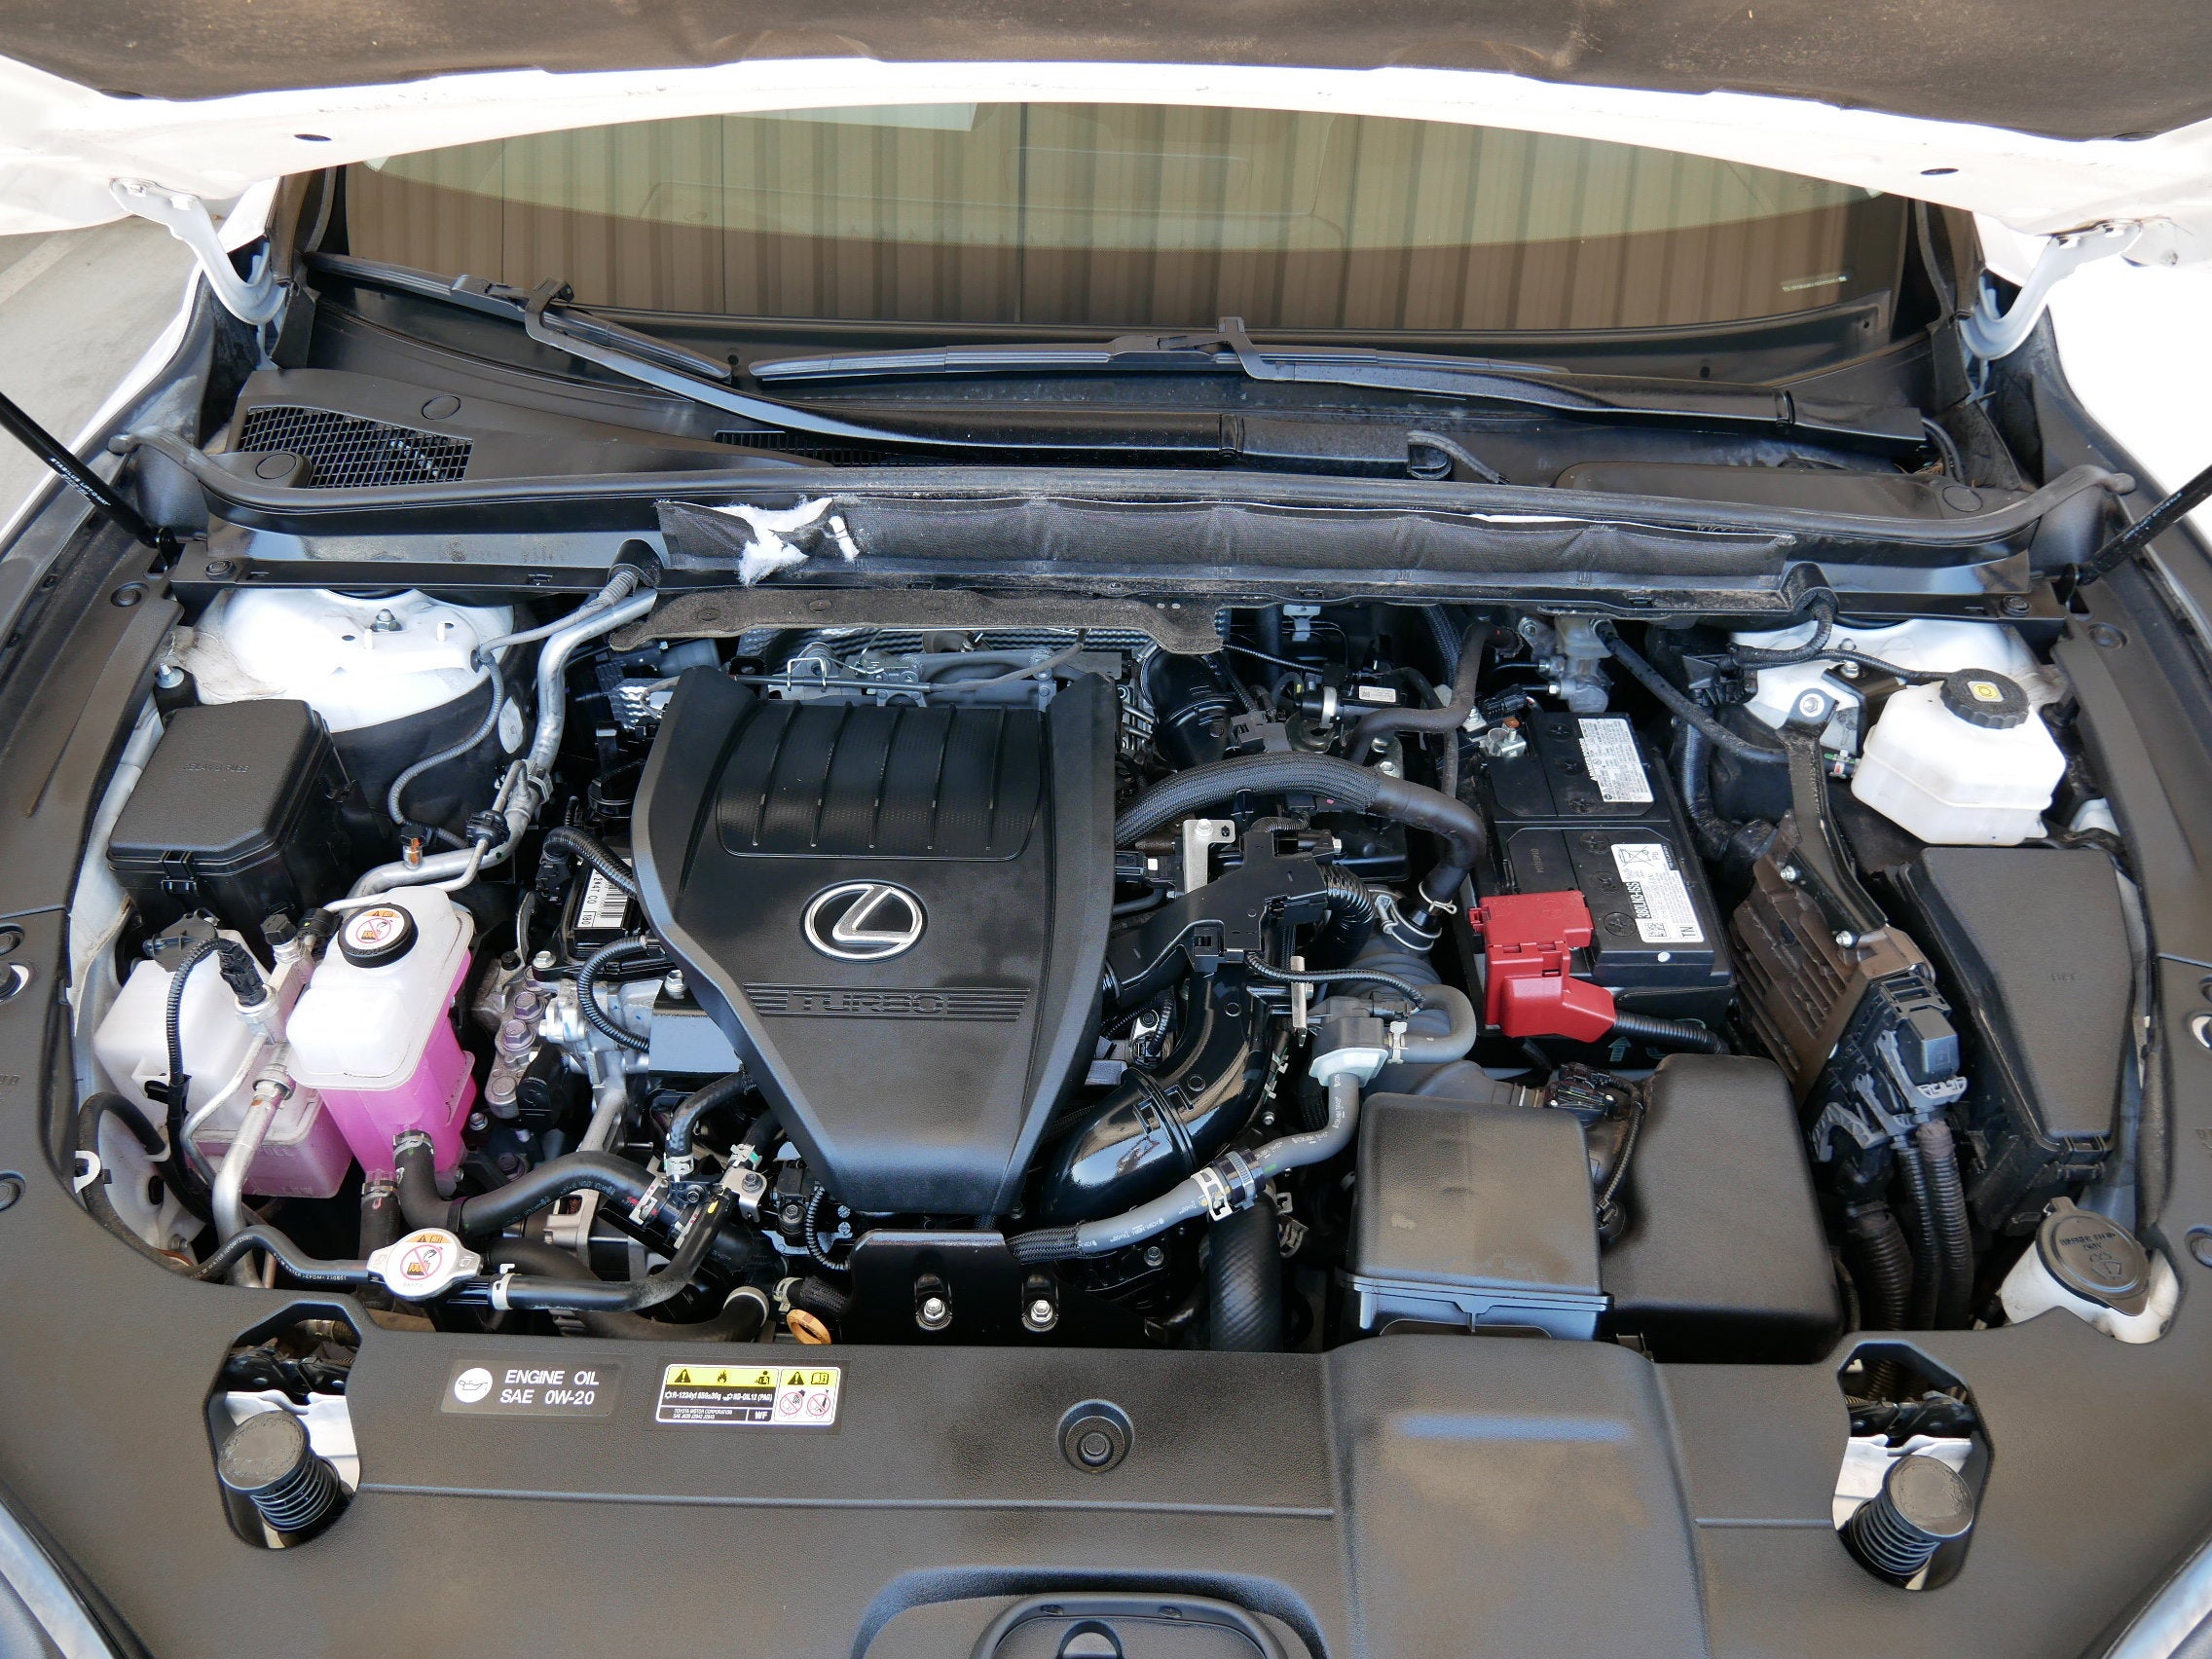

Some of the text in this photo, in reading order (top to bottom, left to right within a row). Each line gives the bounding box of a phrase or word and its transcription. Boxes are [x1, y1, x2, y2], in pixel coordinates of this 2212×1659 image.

[1679, 926, 1695, 938] TN
[793, 990, 944, 1014] TURBO
[504, 1369, 600, 1385] ENGINE OIL
[499, 1388, 595, 1405] SAE 0W-20
[755, 1411, 768, 1419] WF
